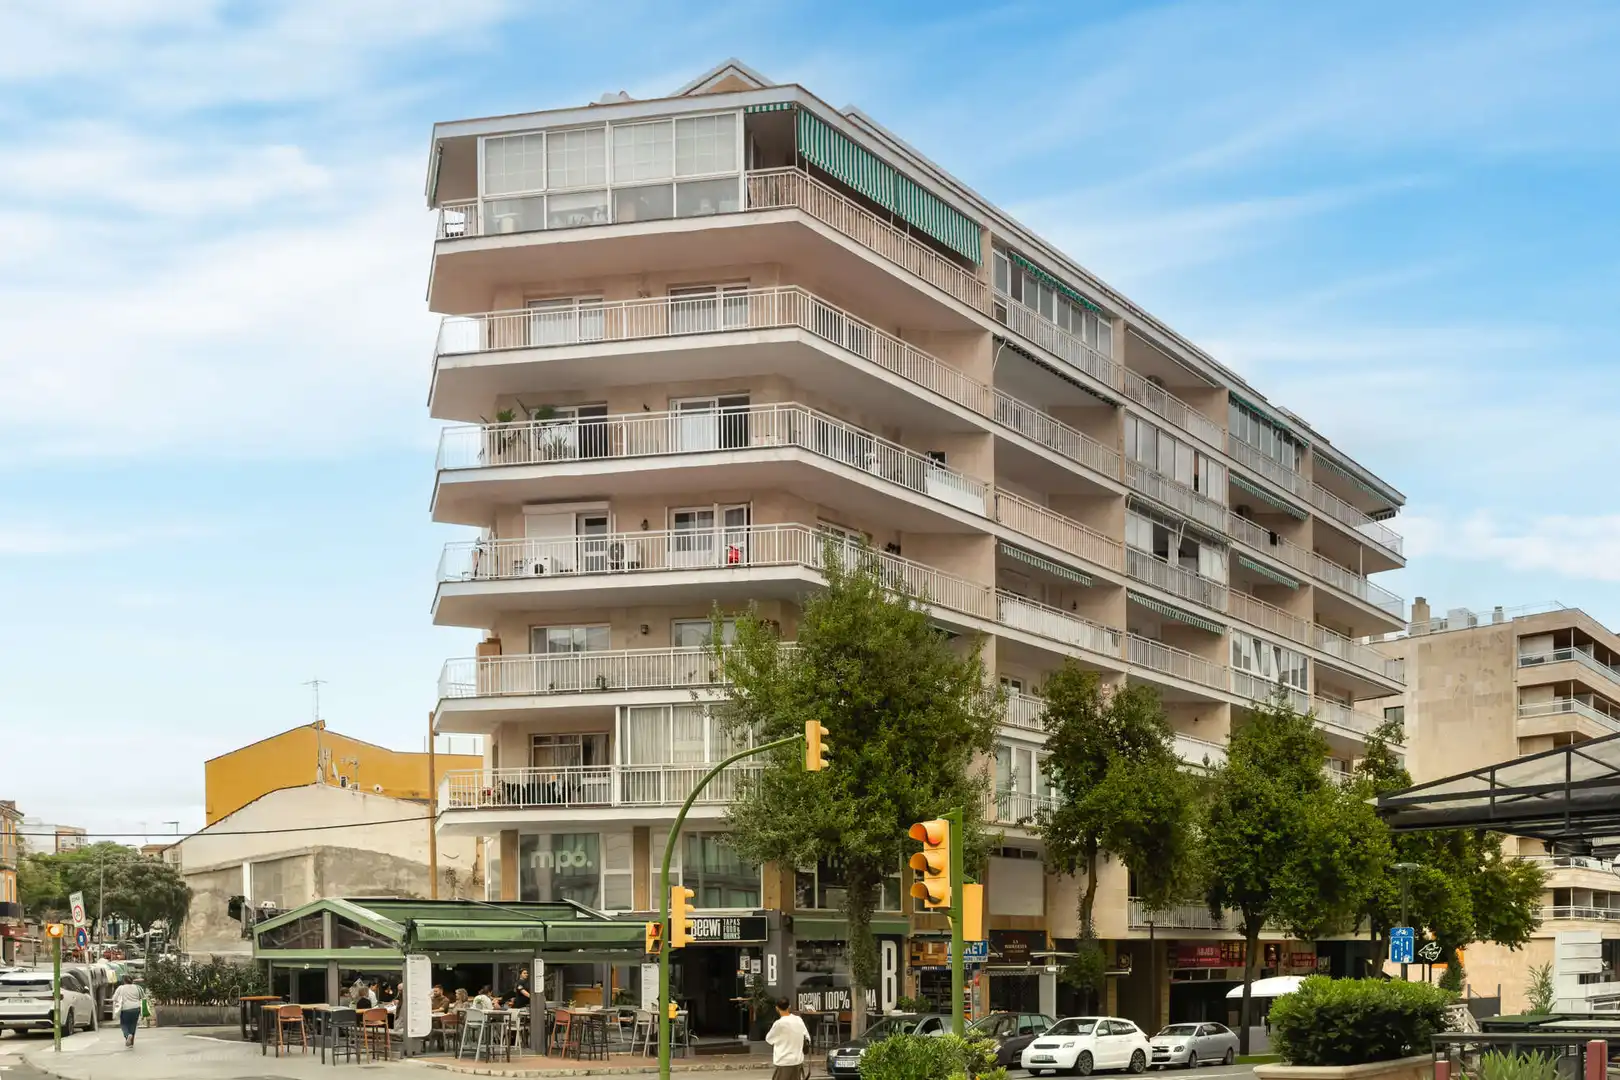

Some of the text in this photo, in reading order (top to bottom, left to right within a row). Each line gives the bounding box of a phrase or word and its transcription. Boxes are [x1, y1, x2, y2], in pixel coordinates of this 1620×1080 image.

[723, 918, 741, 926] TAPAS
[723, 932, 741, 940] DRINKS
[767, 953, 777, 982] B
[881, 940, 897, 1012] B
[825, 990, 850, 1010] 100%
